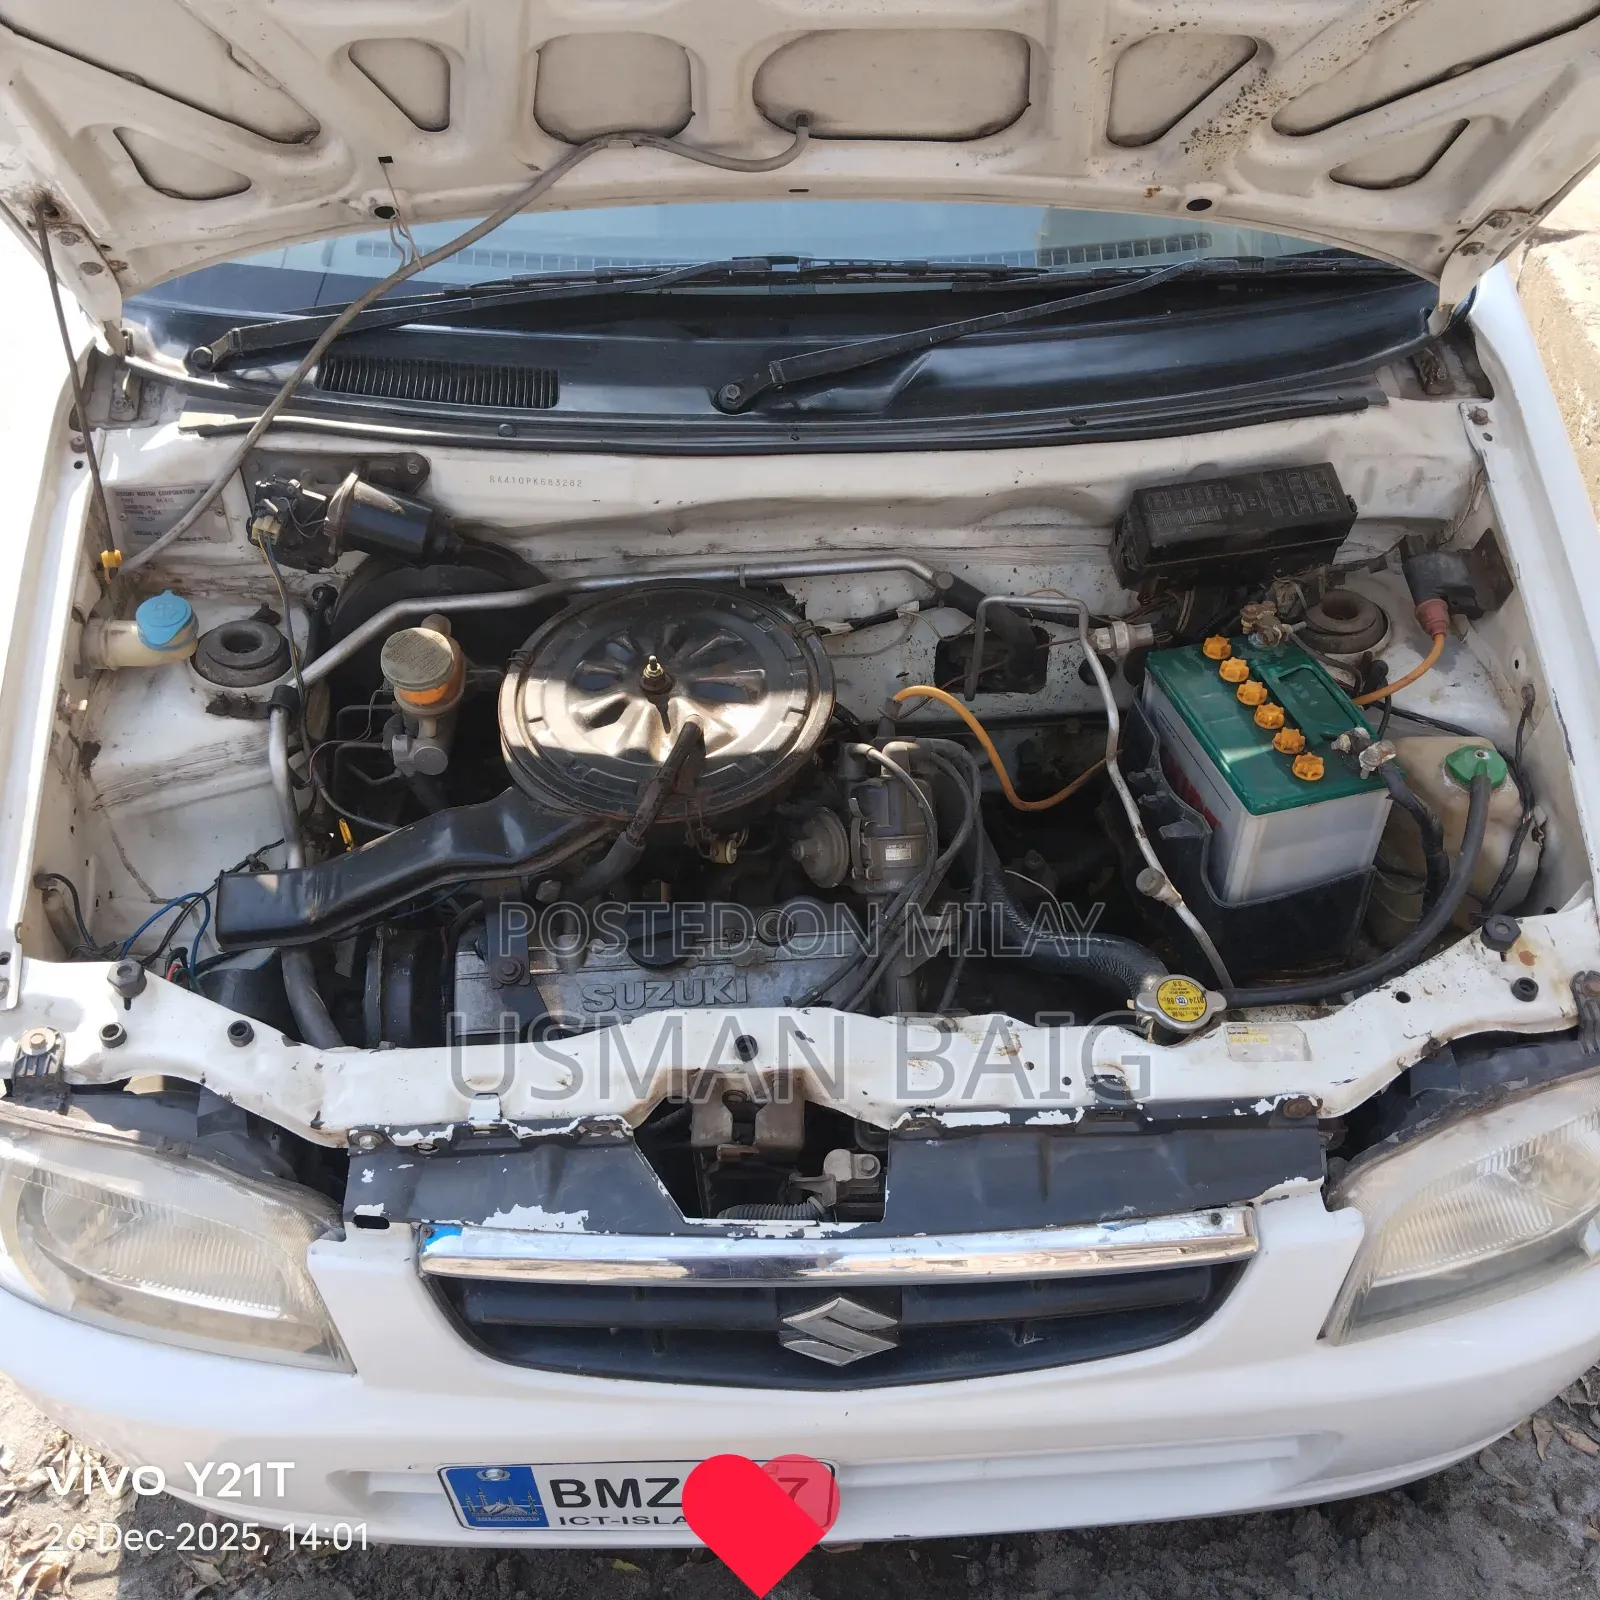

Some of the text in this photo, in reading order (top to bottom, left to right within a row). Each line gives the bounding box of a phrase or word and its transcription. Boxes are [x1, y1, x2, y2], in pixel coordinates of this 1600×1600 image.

[582, 976, 748, 1012] SUZUKI
[549, 1477, 683, 1509] BMZ
[559, 1515, 687, 1526] ICT-ISLA
